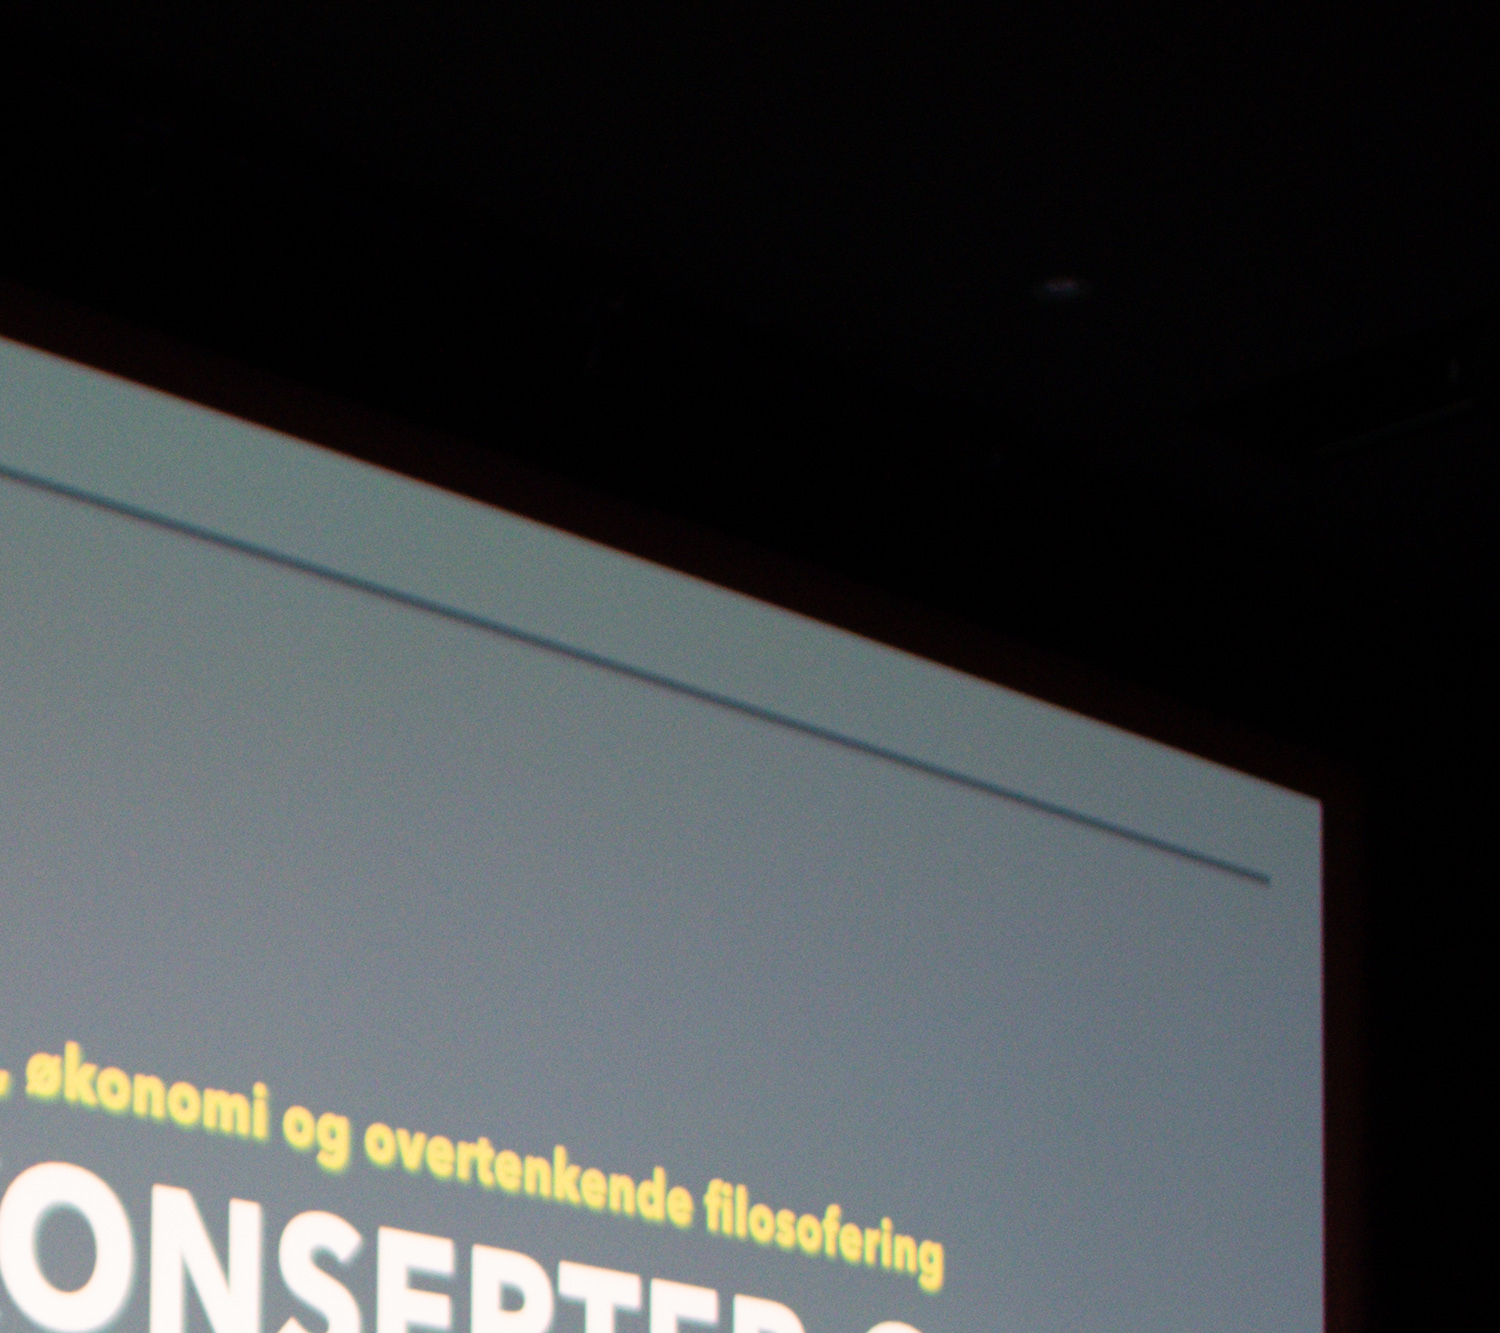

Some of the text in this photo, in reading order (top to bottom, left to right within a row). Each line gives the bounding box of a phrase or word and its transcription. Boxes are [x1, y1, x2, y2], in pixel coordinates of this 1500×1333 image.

[23, 1038, 272, 1143] økonomi
[280, 1102, 354, 1175] og
[362, 1120, 697, 1231] overtenkende
[701, 1175, 947, 1296] filosofering
